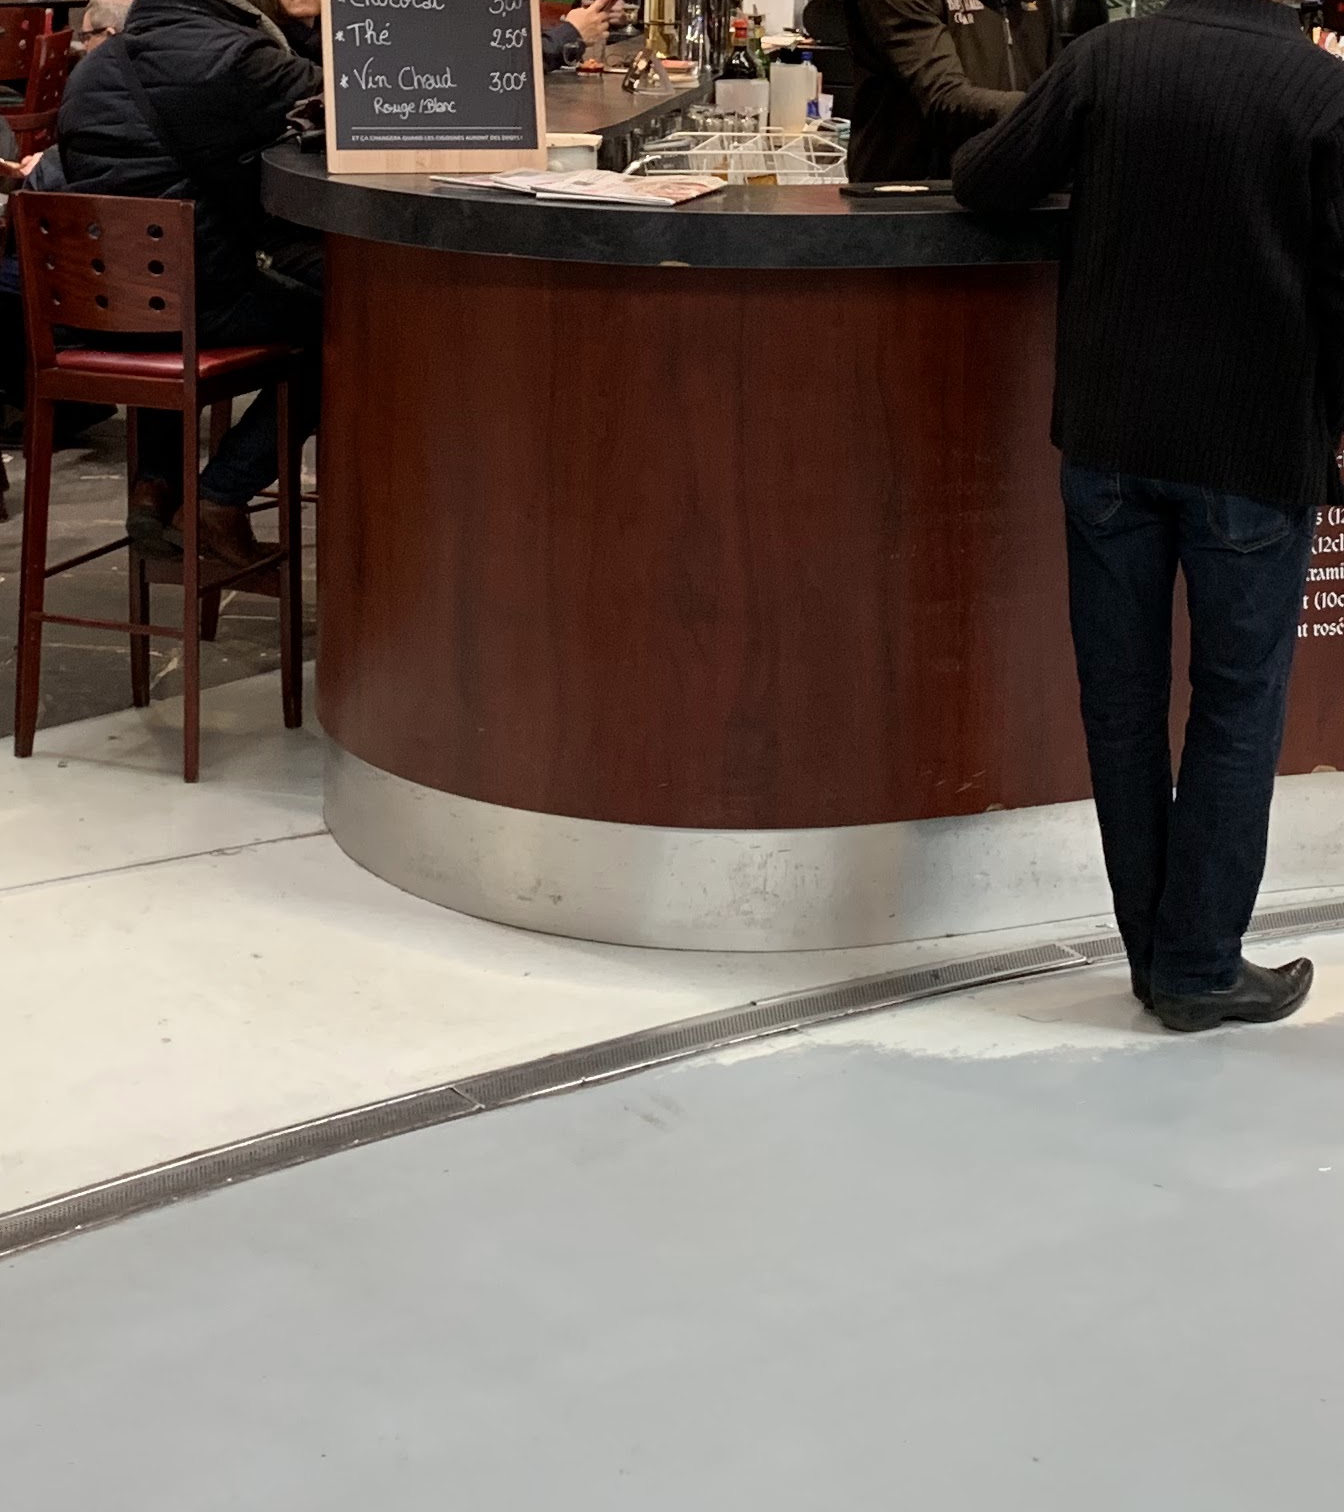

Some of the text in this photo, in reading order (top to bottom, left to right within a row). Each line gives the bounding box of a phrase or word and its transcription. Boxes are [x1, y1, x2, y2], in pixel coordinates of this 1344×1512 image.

[346, 18, 392, 47] Thé
[353, 56, 392, 90] Vin
[398, 66, 457, 90] Chaud
[374, 97, 416, 120] Rouge
[1312, 617, 1344, 637] rosé
